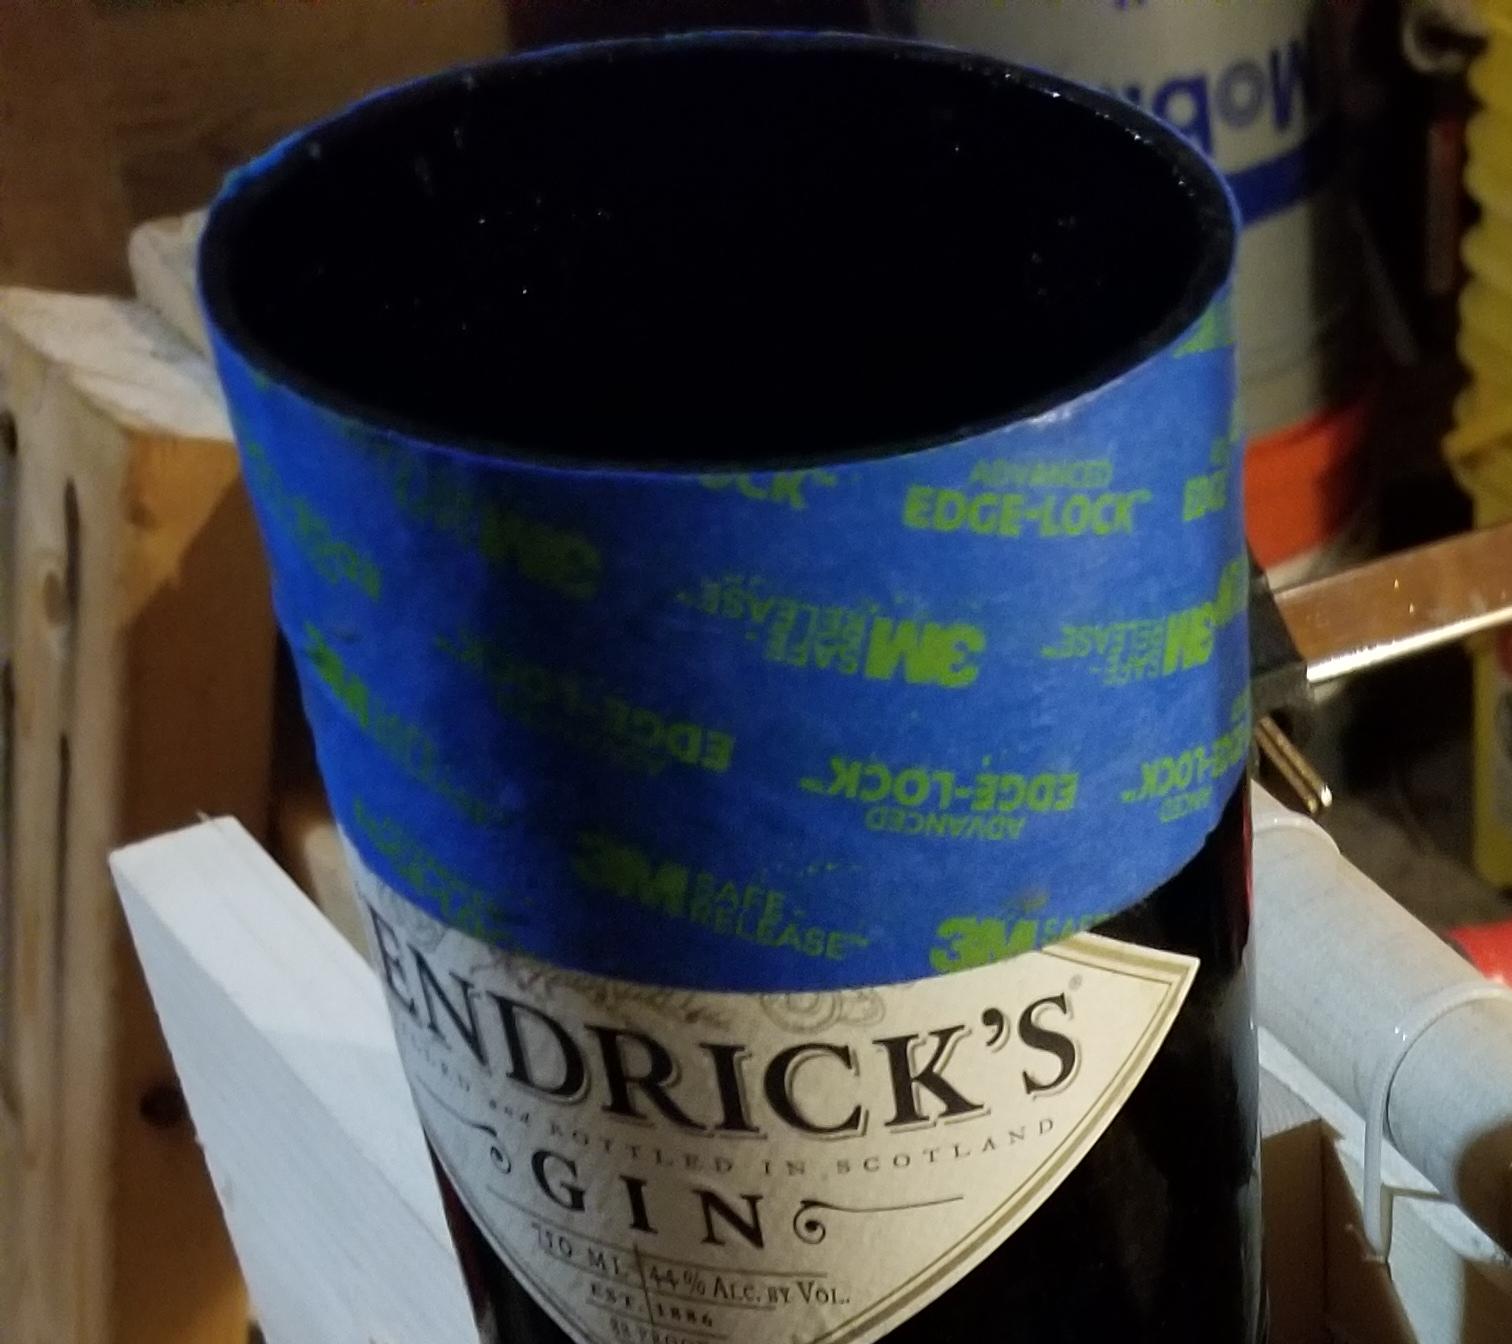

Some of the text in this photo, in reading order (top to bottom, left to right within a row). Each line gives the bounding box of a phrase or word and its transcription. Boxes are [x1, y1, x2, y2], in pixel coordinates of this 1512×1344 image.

[863, 615, 987, 689] 3M
[864, 807, 1025, 841] ADVANCED
[928, 914, 1036, 974] 3M
[368, 906, 1082, 1141] ENDRICK'S
[836, 1116, 1056, 1176] SCOTLAND
[530, 1148, 765, 1250] GIN
